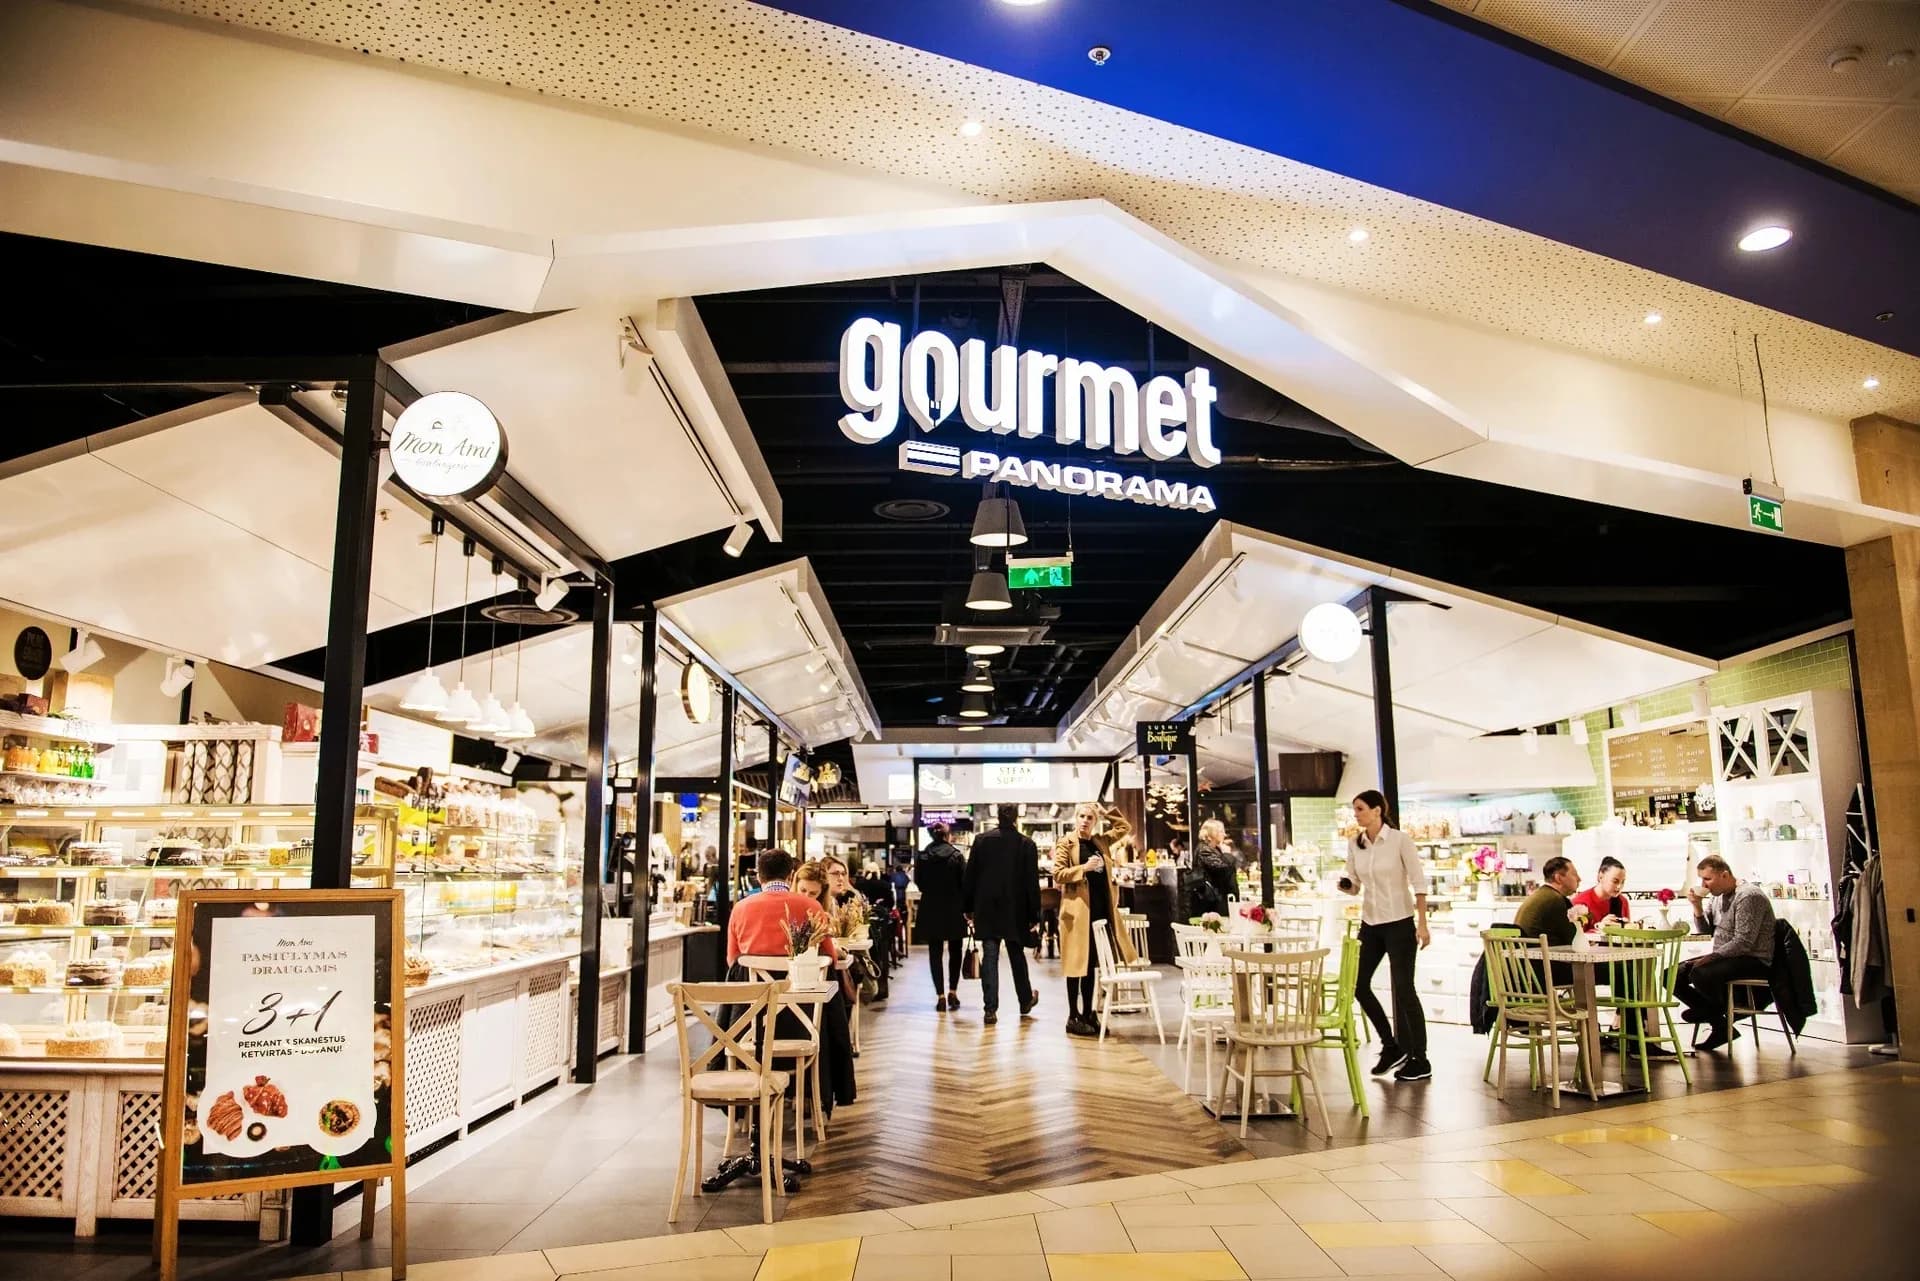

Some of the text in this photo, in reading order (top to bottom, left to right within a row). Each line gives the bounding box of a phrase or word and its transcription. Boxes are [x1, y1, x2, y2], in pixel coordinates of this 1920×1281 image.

[838, 316, 1222, 469] gourmet
[394, 431, 496, 459] Mon Ami
[962, 450, 1217, 513] PANORAMA
[999, 767, 1033, 776] STEAK
[251, 963, 338, 975] DRAUGAMS
[242, 990, 343, 1035] 3+1
[238, 1039, 283, 1049] PERKANT
[241, 1048, 293, 1058] KETVIRTAS
